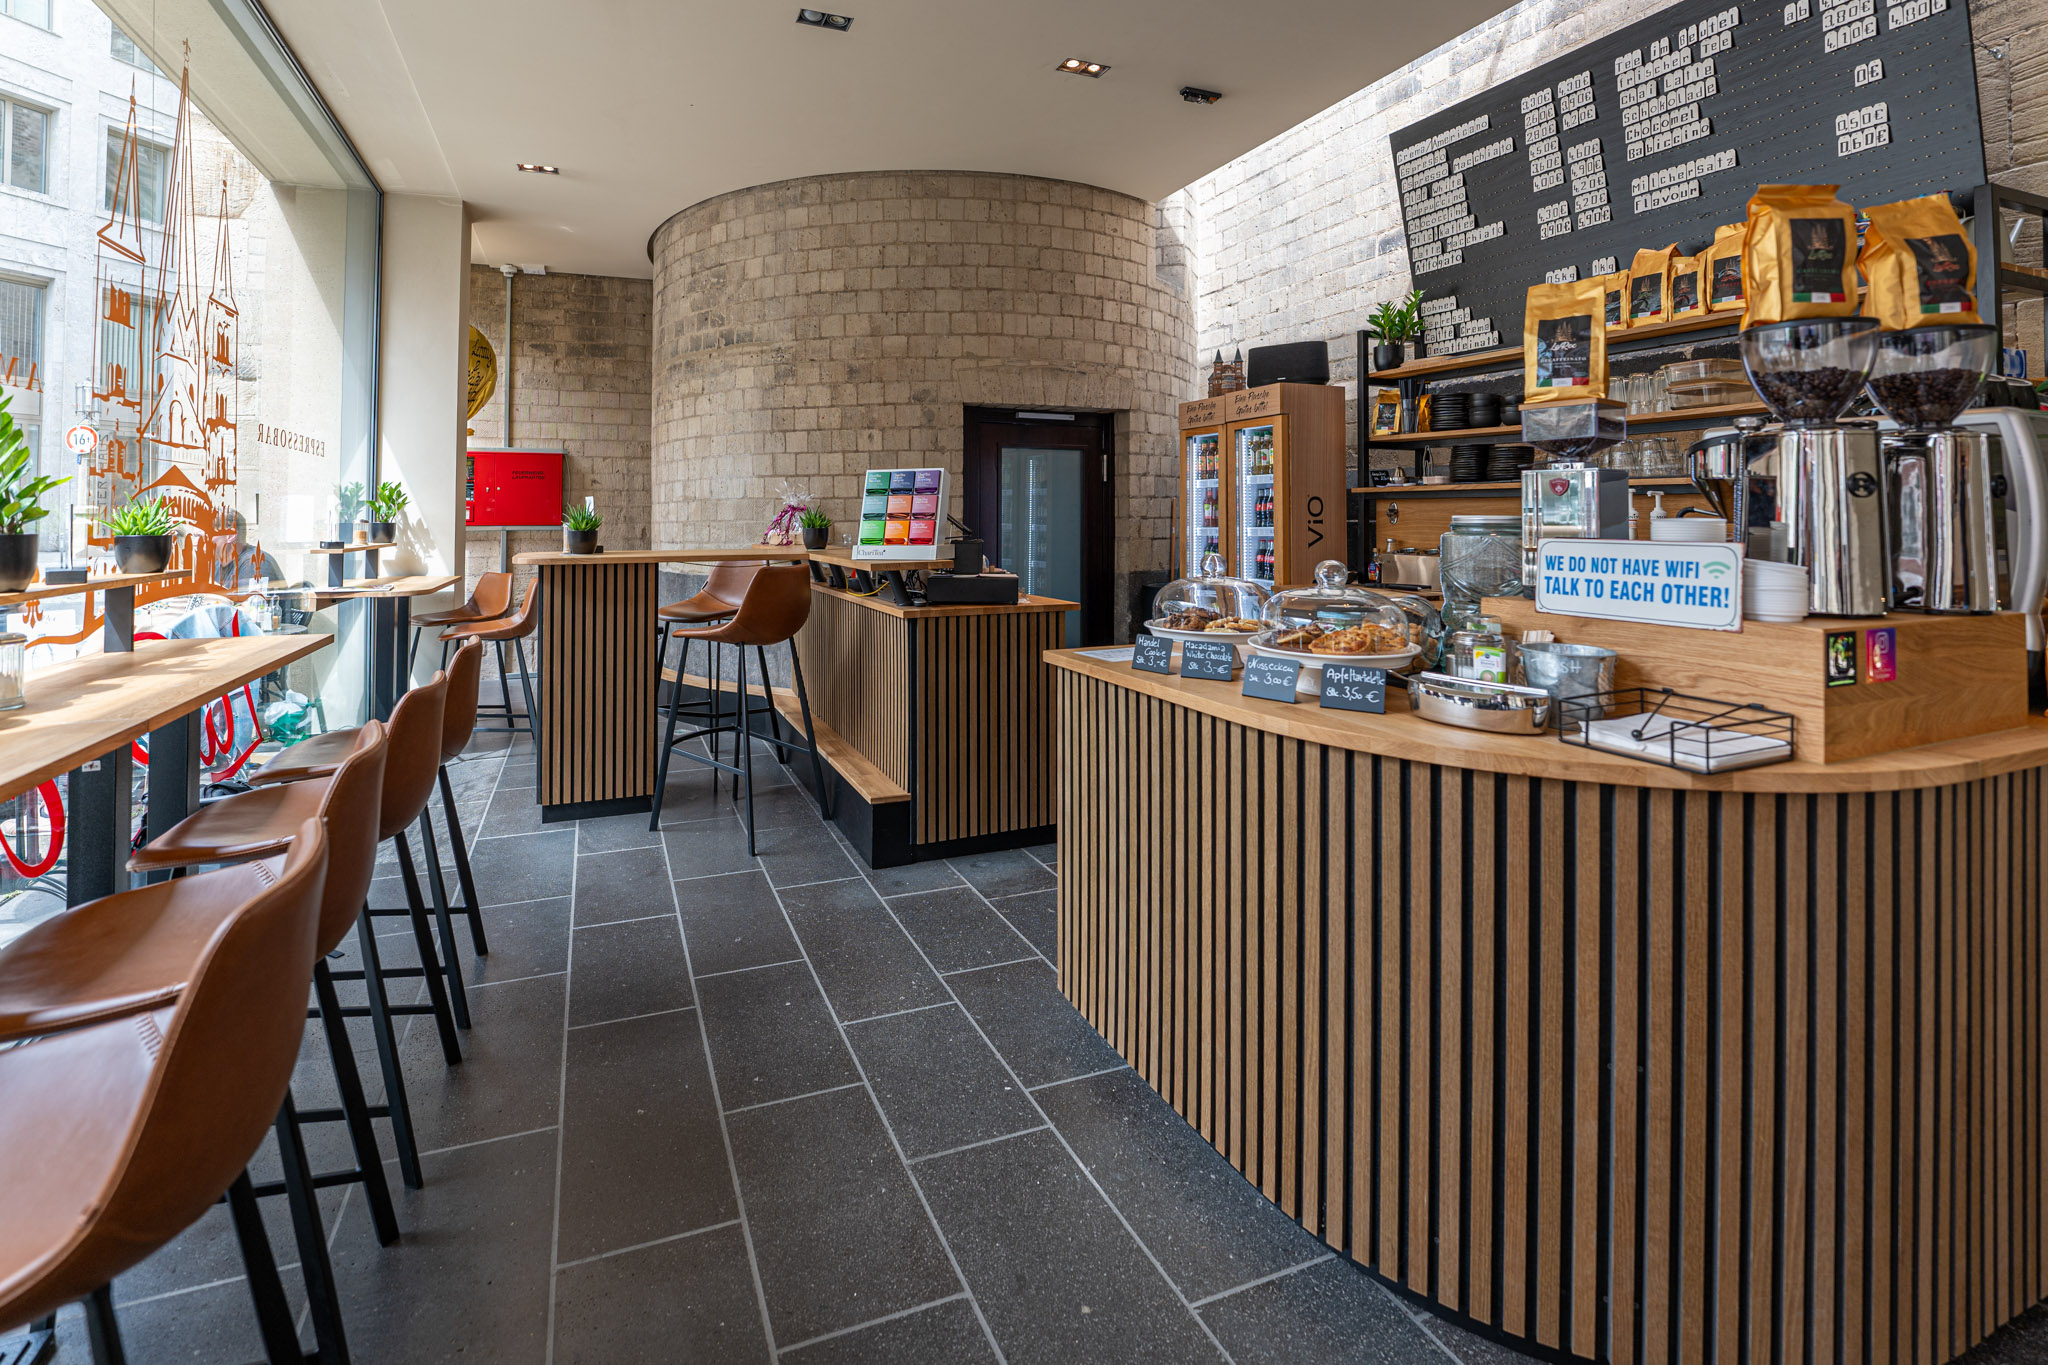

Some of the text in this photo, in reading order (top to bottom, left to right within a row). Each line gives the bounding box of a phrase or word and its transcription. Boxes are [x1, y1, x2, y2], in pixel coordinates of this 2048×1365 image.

[1786, 6, 1807, 21] ab
[1825, 0, 1870, 28] 3,80€
[1616, 13, 1734, 73] Tee im Beutel
[1827, 22, 1874, 48] 4,10€
[1619, 37, 1729, 88] frischer Tee
[1856, 64, 1879, 83] 0€
[1621, 65, 1712, 105] Chai Latte
[1623, 83, 1715, 124] Schokolade
[1626, 109, 1695, 141] Chocomel
[1837, 108, 1884, 132] 0,50€
[1628, 124, 1709, 159] Babiccino
[1840, 129, 1887, 154] 0,60€
[1400, 152, 1447, 177] Espresso
[1402, 143, 1512, 191] Espresso Macchiato
[1632, 157, 1735, 193] Milchersatz
[1432, 177, 1462, 194] White
[1406, 191, 1465, 217] Cappuccino
[1635, 188, 1697, 211] Flavour
[1413, 226, 1503, 260] Latte Macchiato
[1416, 254, 1462, 273] Affogato
[1421, 302, 1455, 315] Bohnen
[1427, 335, 1498, 356] Decaffeinato
[1545, 554, 1700, 580] WE DO NOT HAVE WIFI
[1544, 576, 1730, 609] TALK TO EACH OTHER!
[1138, 636, 1161, 648] Mandel
[1144, 647, 1167, 658] Cookie
[1185, 641, 1226, 652] Macadamia
[1185, 650, 1205, 659] White
[1248, 657, 1294, 673] Nussecken
